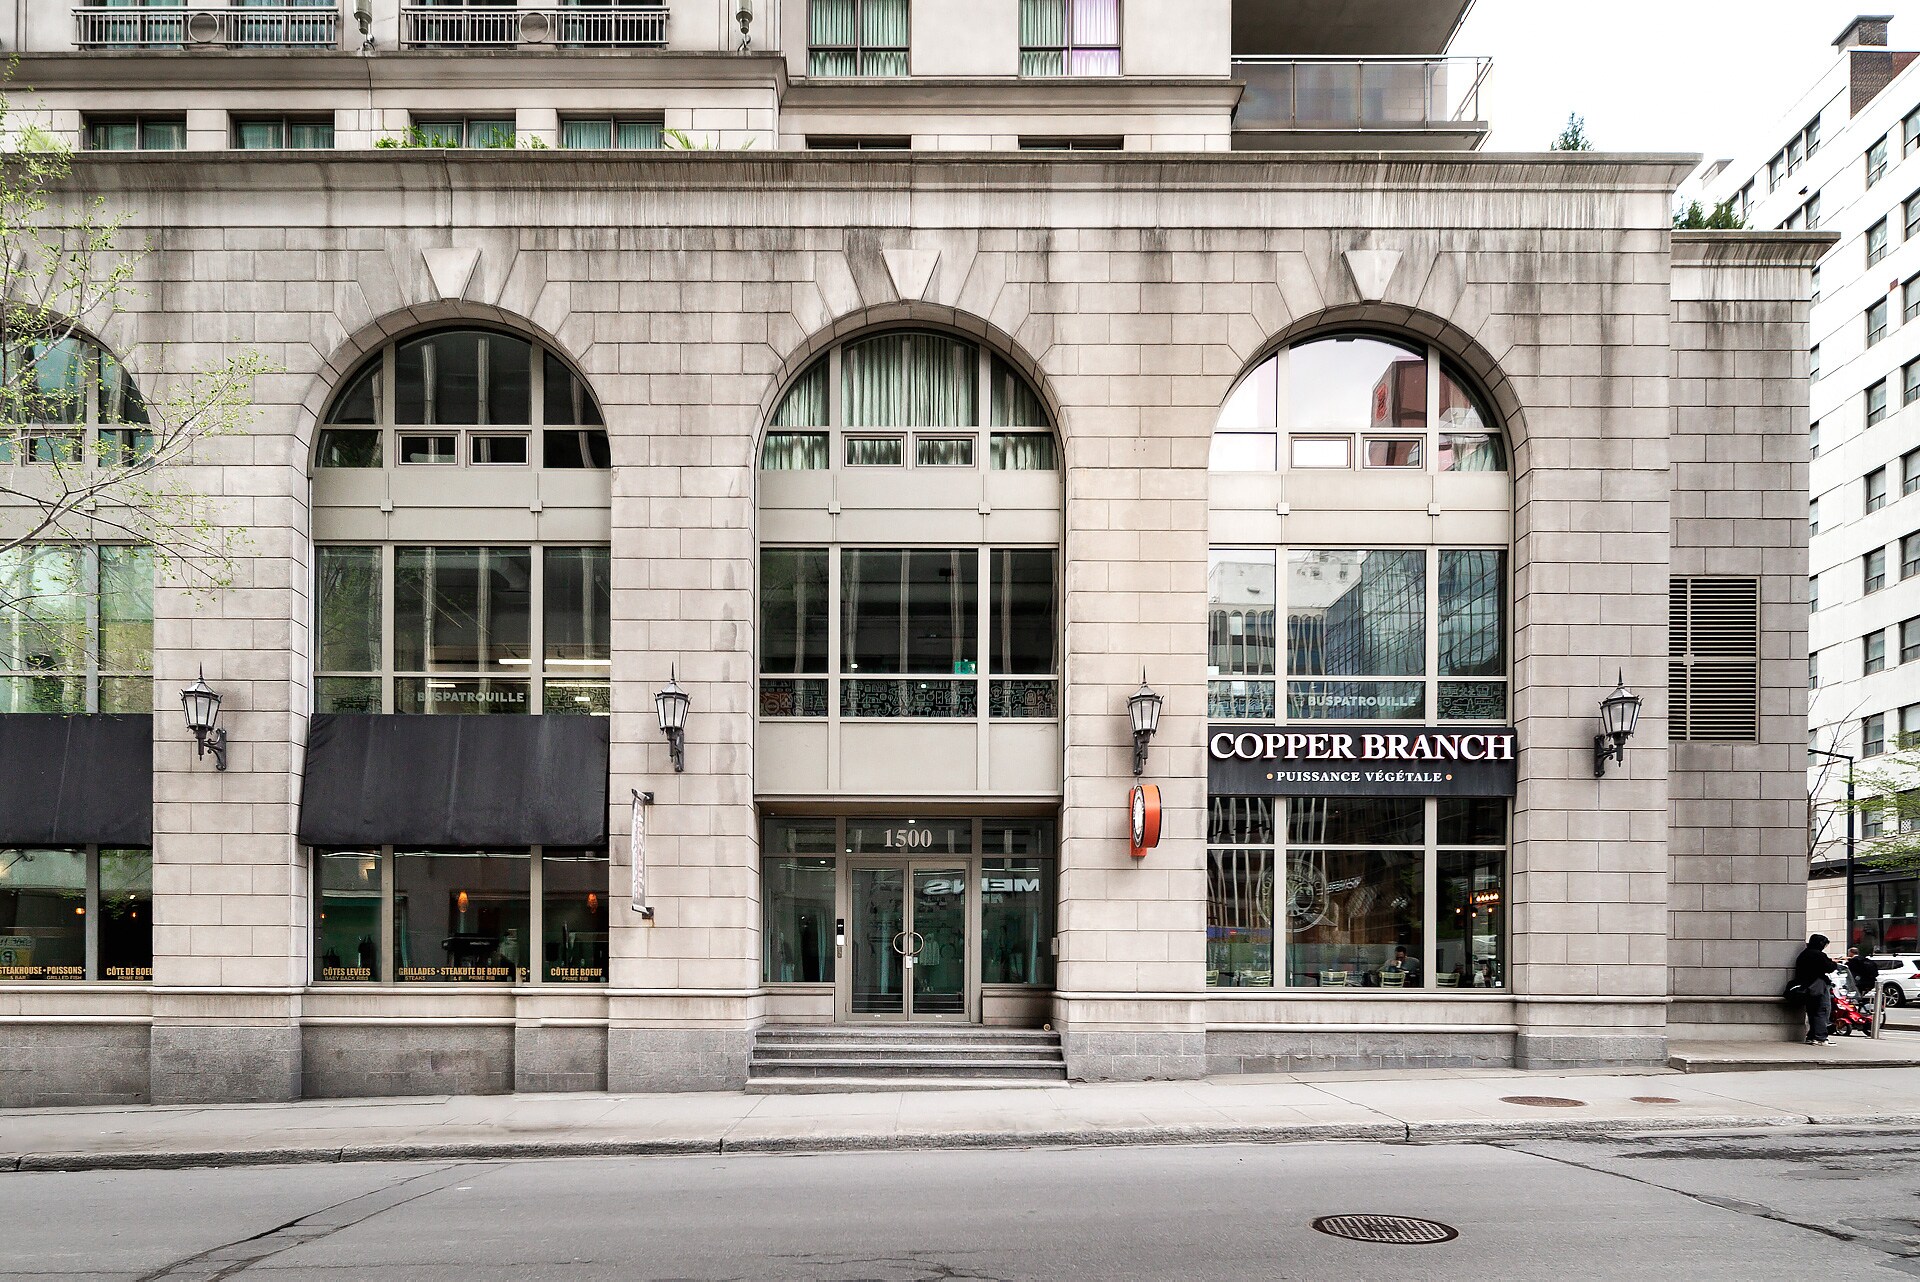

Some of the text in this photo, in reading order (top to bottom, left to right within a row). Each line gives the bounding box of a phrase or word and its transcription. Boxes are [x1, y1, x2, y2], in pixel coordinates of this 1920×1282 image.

[1307, 695, 1416, 707] BUSPATROUILLE
[1210, 732, 1515, 760] COPPER BRANCH
[1277, 769, 1443, 783] PUISSANCE VÉGÉTALE
[884, 829, 932, 848] 1500
[46, 966, 83, 975] POISSONS
[106, 966, 153, 976] CÔTE DE BOEU
[323, 966, 346, 976] CÔTES
[398, 967, 436, 976] GRILLADES
[476, 967, 509, 976] DE BOEUF
[550, 966, 603, 976] CÔTE DE BOEUF
